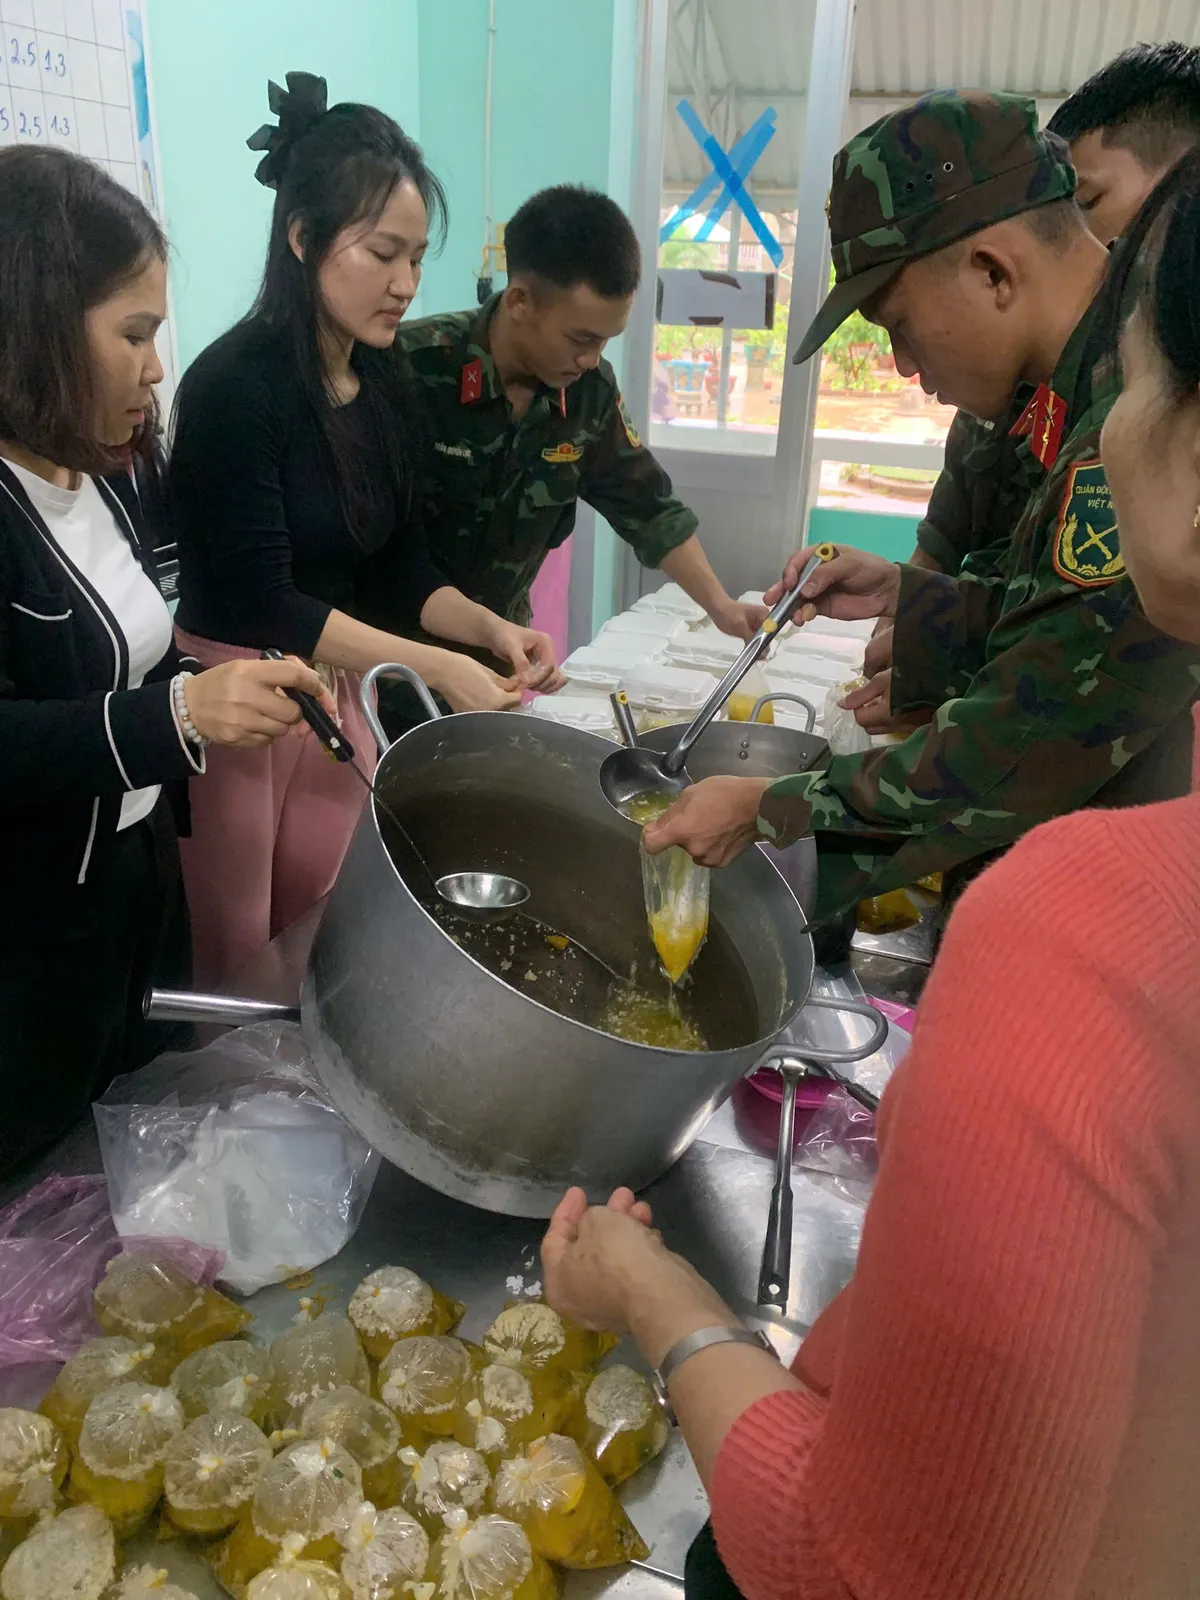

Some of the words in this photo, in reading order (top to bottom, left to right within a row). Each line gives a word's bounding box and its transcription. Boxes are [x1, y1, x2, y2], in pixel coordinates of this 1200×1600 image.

[11, 38, 35, 67] 2,5
[45, 49, 66, 77] 1,3
[19, 111, 42, 138] 2,5
[1076, 484, 1095, 494] QUÂN
[1087, 498, 1106, 509] VIỆT
